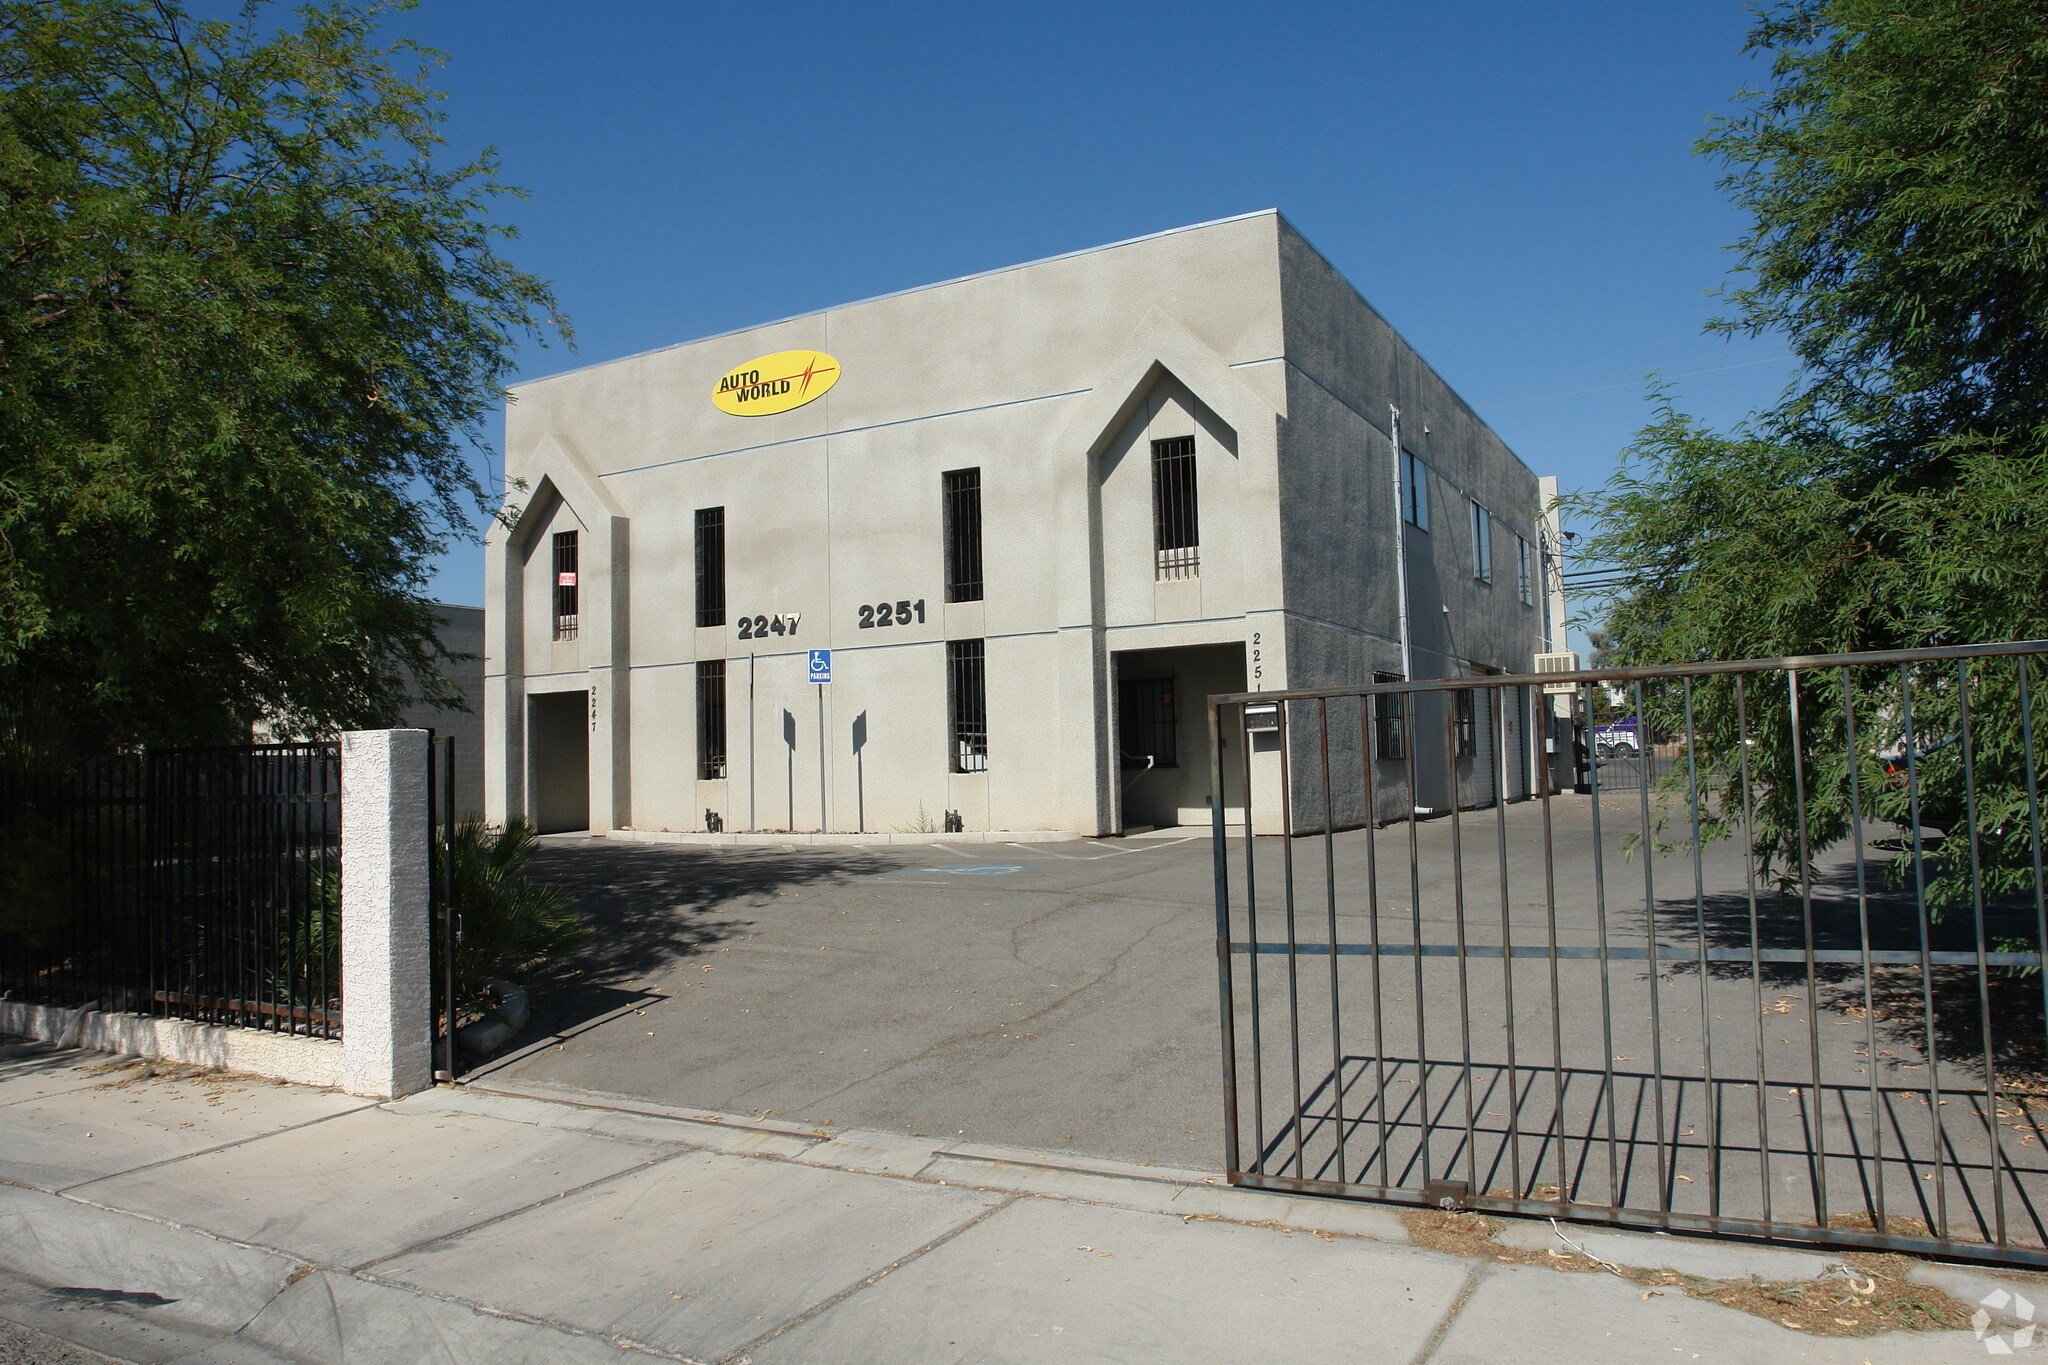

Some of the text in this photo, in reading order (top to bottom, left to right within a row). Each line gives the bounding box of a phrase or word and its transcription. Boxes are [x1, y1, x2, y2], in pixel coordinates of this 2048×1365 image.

[720, 369, 759, 392] AUTO
[736, 380, 790, 402] WORLD
[738, 612, 801, 639] 2247
[858, 599, 925, 629] 2251
[1253, 632, 1262, 692] 2251
[810, 672, 830, 680] PARKING
